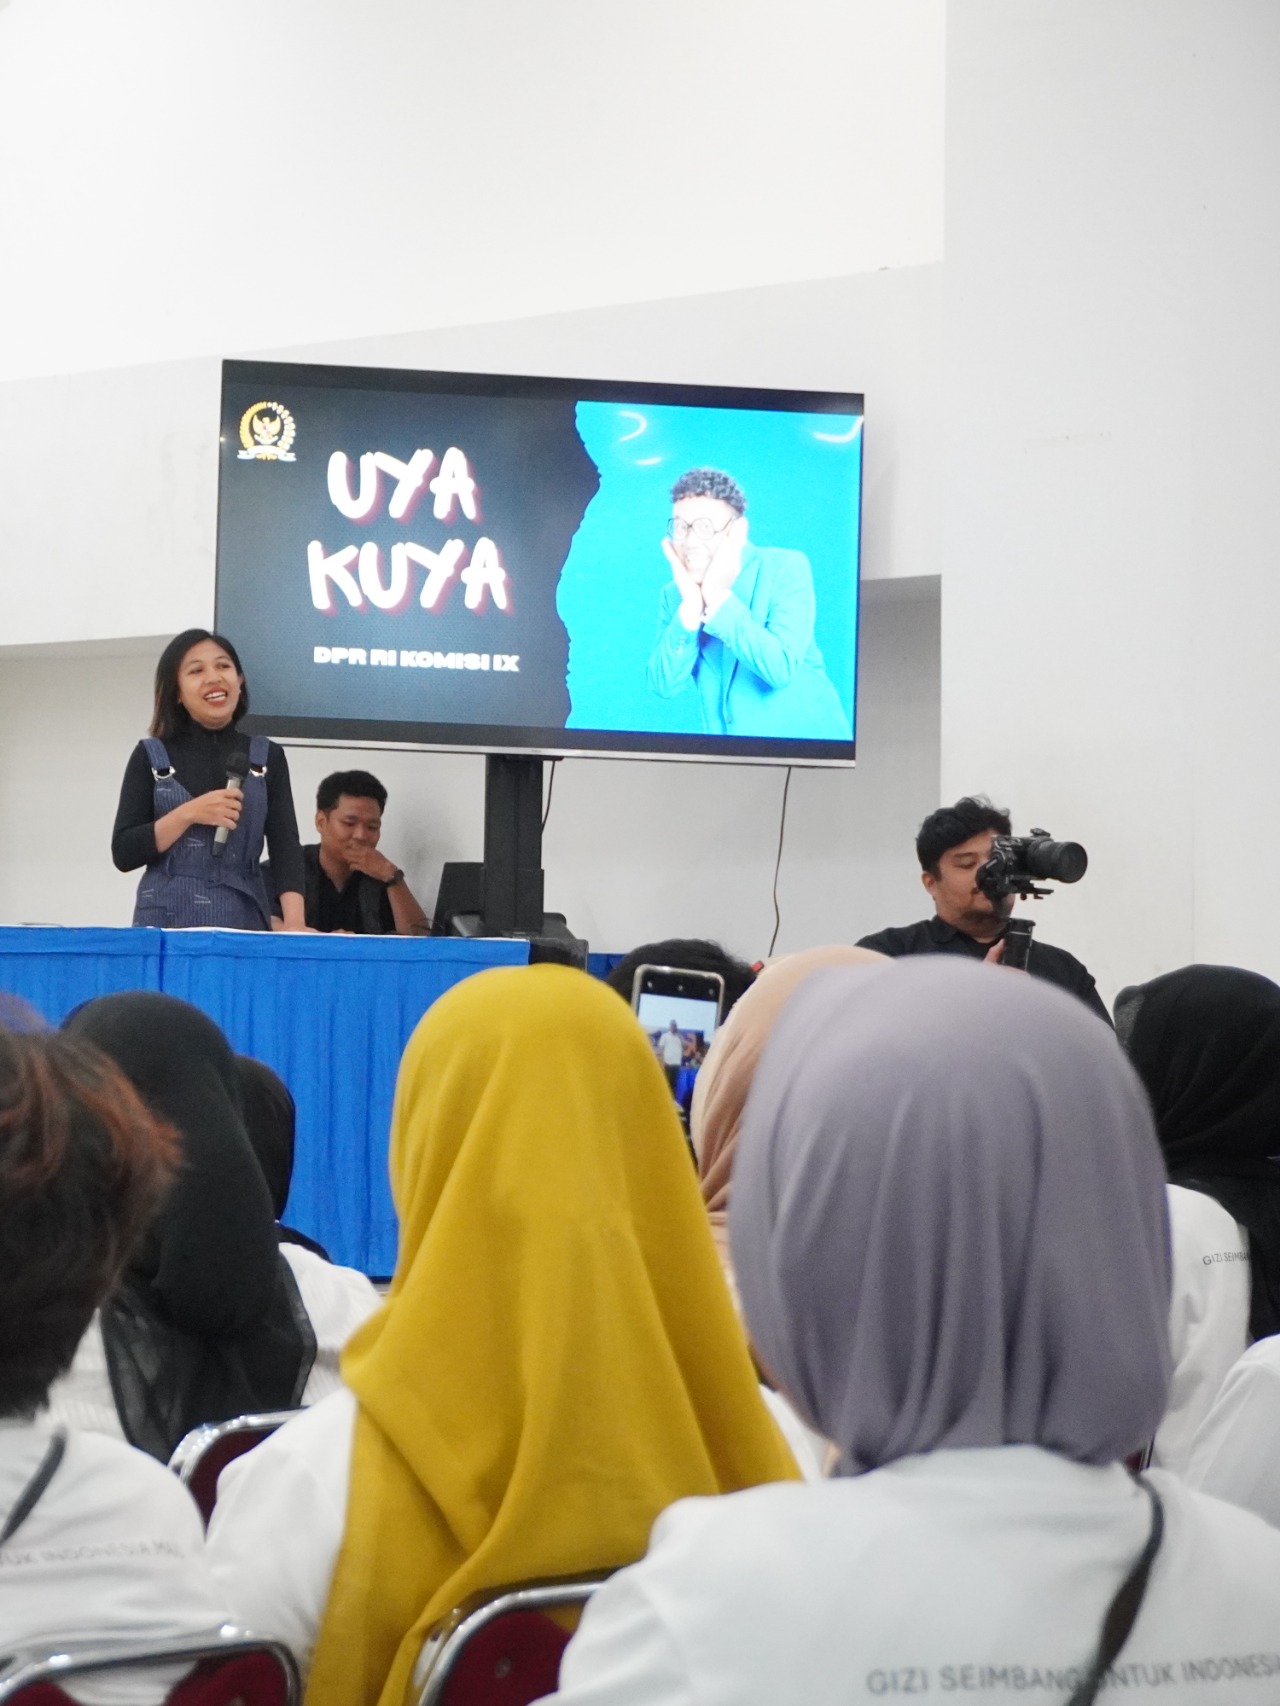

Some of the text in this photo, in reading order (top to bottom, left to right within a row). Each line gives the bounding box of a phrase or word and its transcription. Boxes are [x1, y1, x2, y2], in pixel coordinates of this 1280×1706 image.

[327, 447, 476, 519] UYA
[307, 536, 507, 610] KUYA
[313, 646, 520, 672] DPR RI KOMISI IX
[1202, 1252, 1222, 1266] GIZI
[866, 1666, 930, 1695] GIZI
